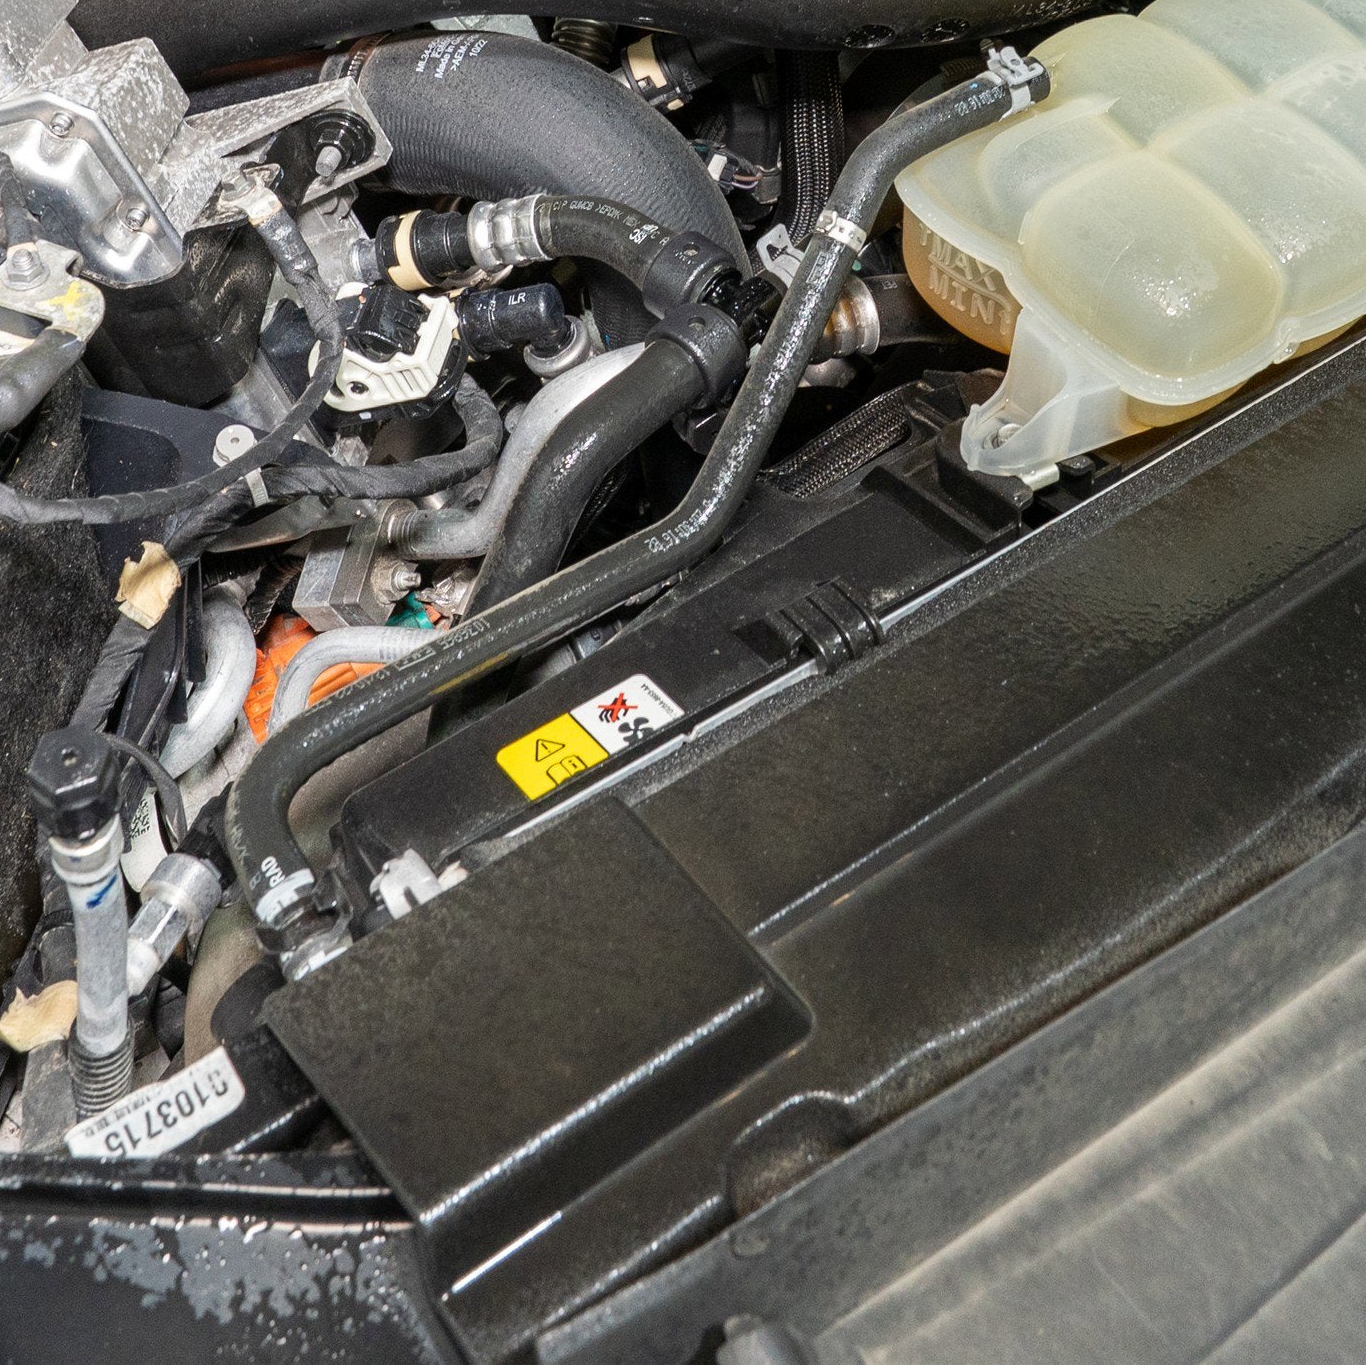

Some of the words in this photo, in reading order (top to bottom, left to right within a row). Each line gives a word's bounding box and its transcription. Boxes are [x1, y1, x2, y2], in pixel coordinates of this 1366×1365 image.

[931, 233, 997, 292] MAX
[928, 263, 994, 325] MIN
[261, 856, 285, 888] RAD
